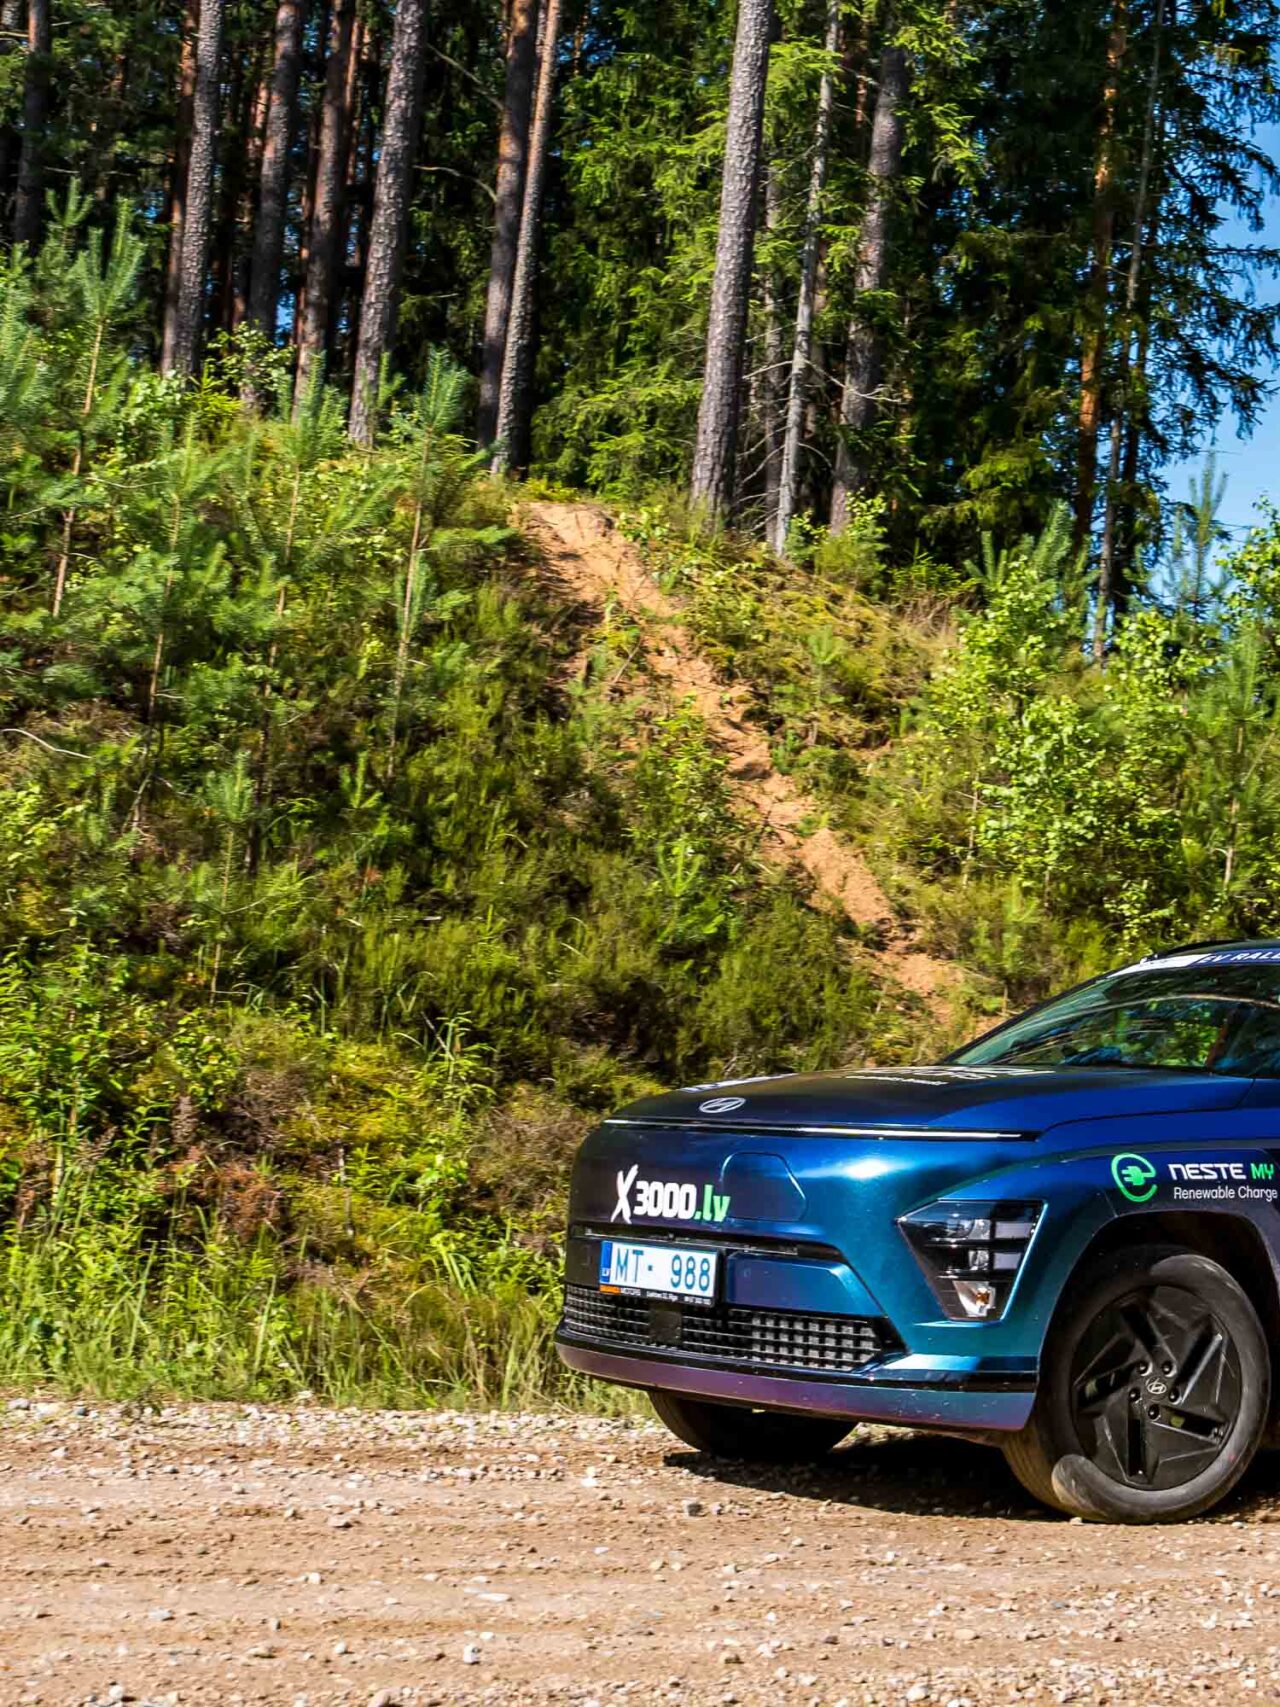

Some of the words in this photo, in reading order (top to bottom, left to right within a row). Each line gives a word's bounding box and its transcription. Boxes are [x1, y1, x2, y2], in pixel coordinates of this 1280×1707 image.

[1167, 1162, 1247, 1181] NESTE
[1251, 1162, 1275, 1181] MY
[610, 1164, 731, 1225] X3000.lv
[1173, 1186, 1235, 1200] Renewable
[1238, 1186, 1278, 1202] Charge
[670, 1254, 711, 1292] 988
